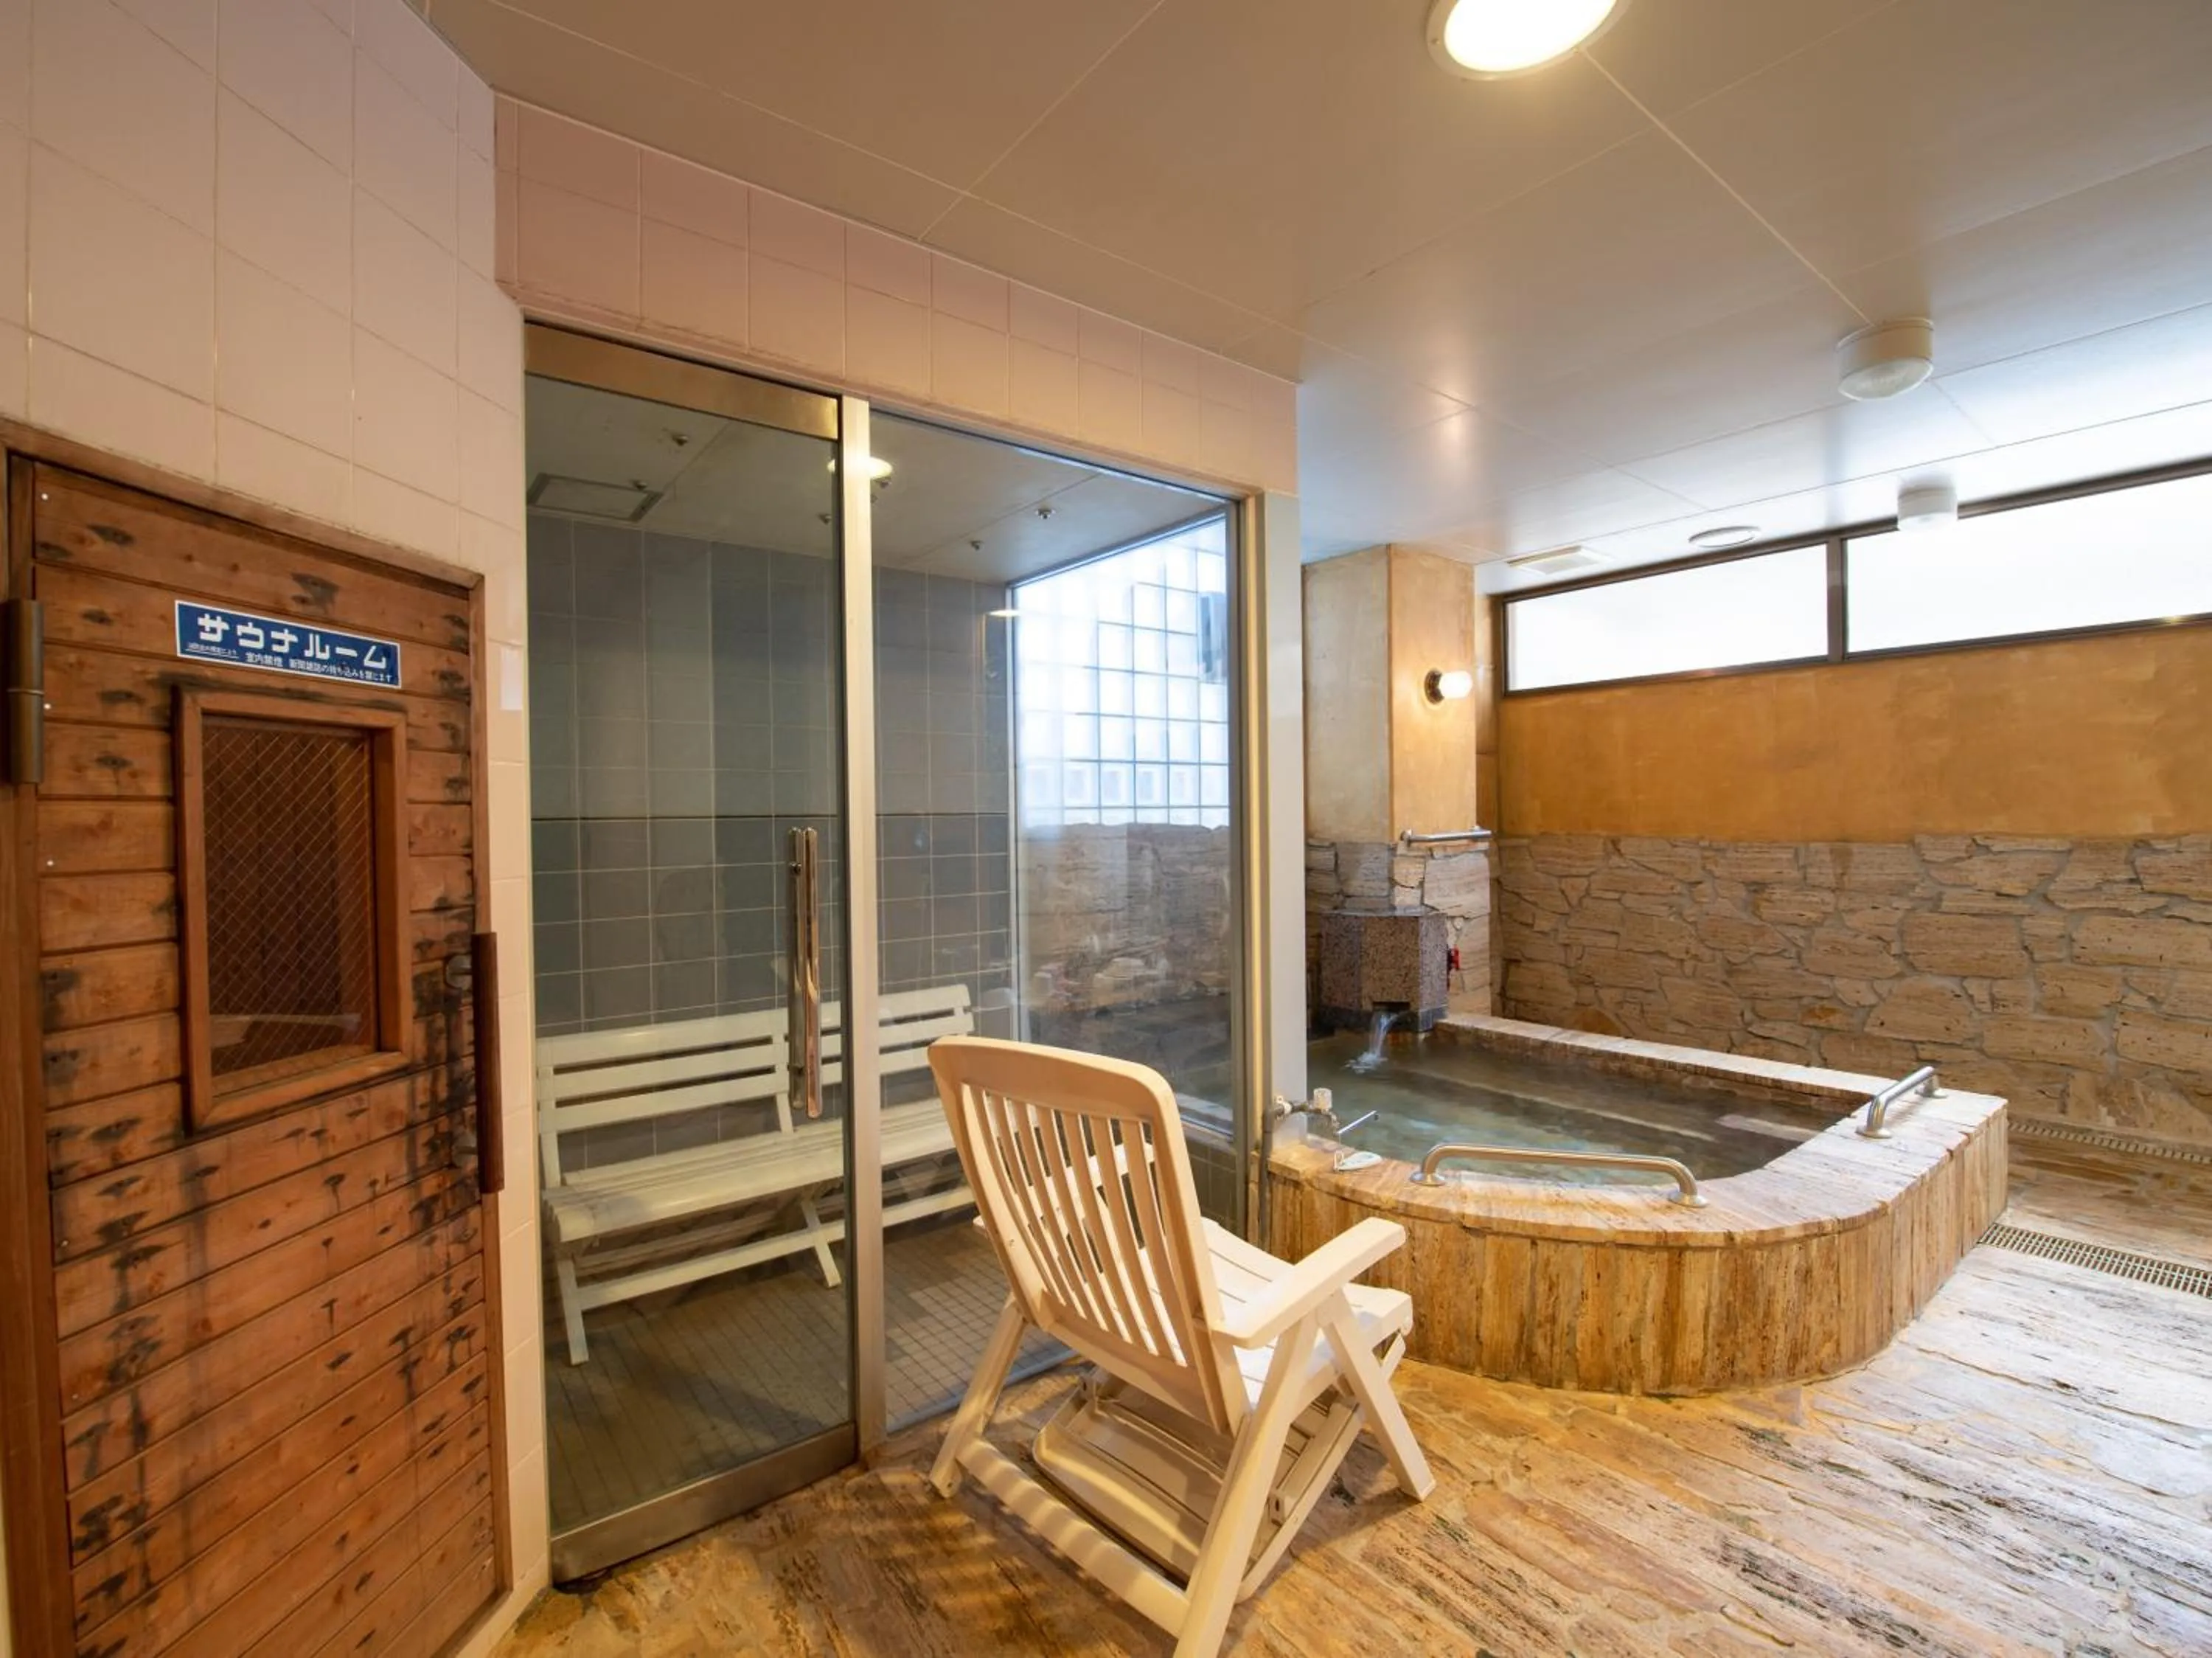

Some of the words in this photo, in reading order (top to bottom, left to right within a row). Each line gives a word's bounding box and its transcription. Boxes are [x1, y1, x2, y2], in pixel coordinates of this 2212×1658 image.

[197, 613, 387, 670] サウナルーム
